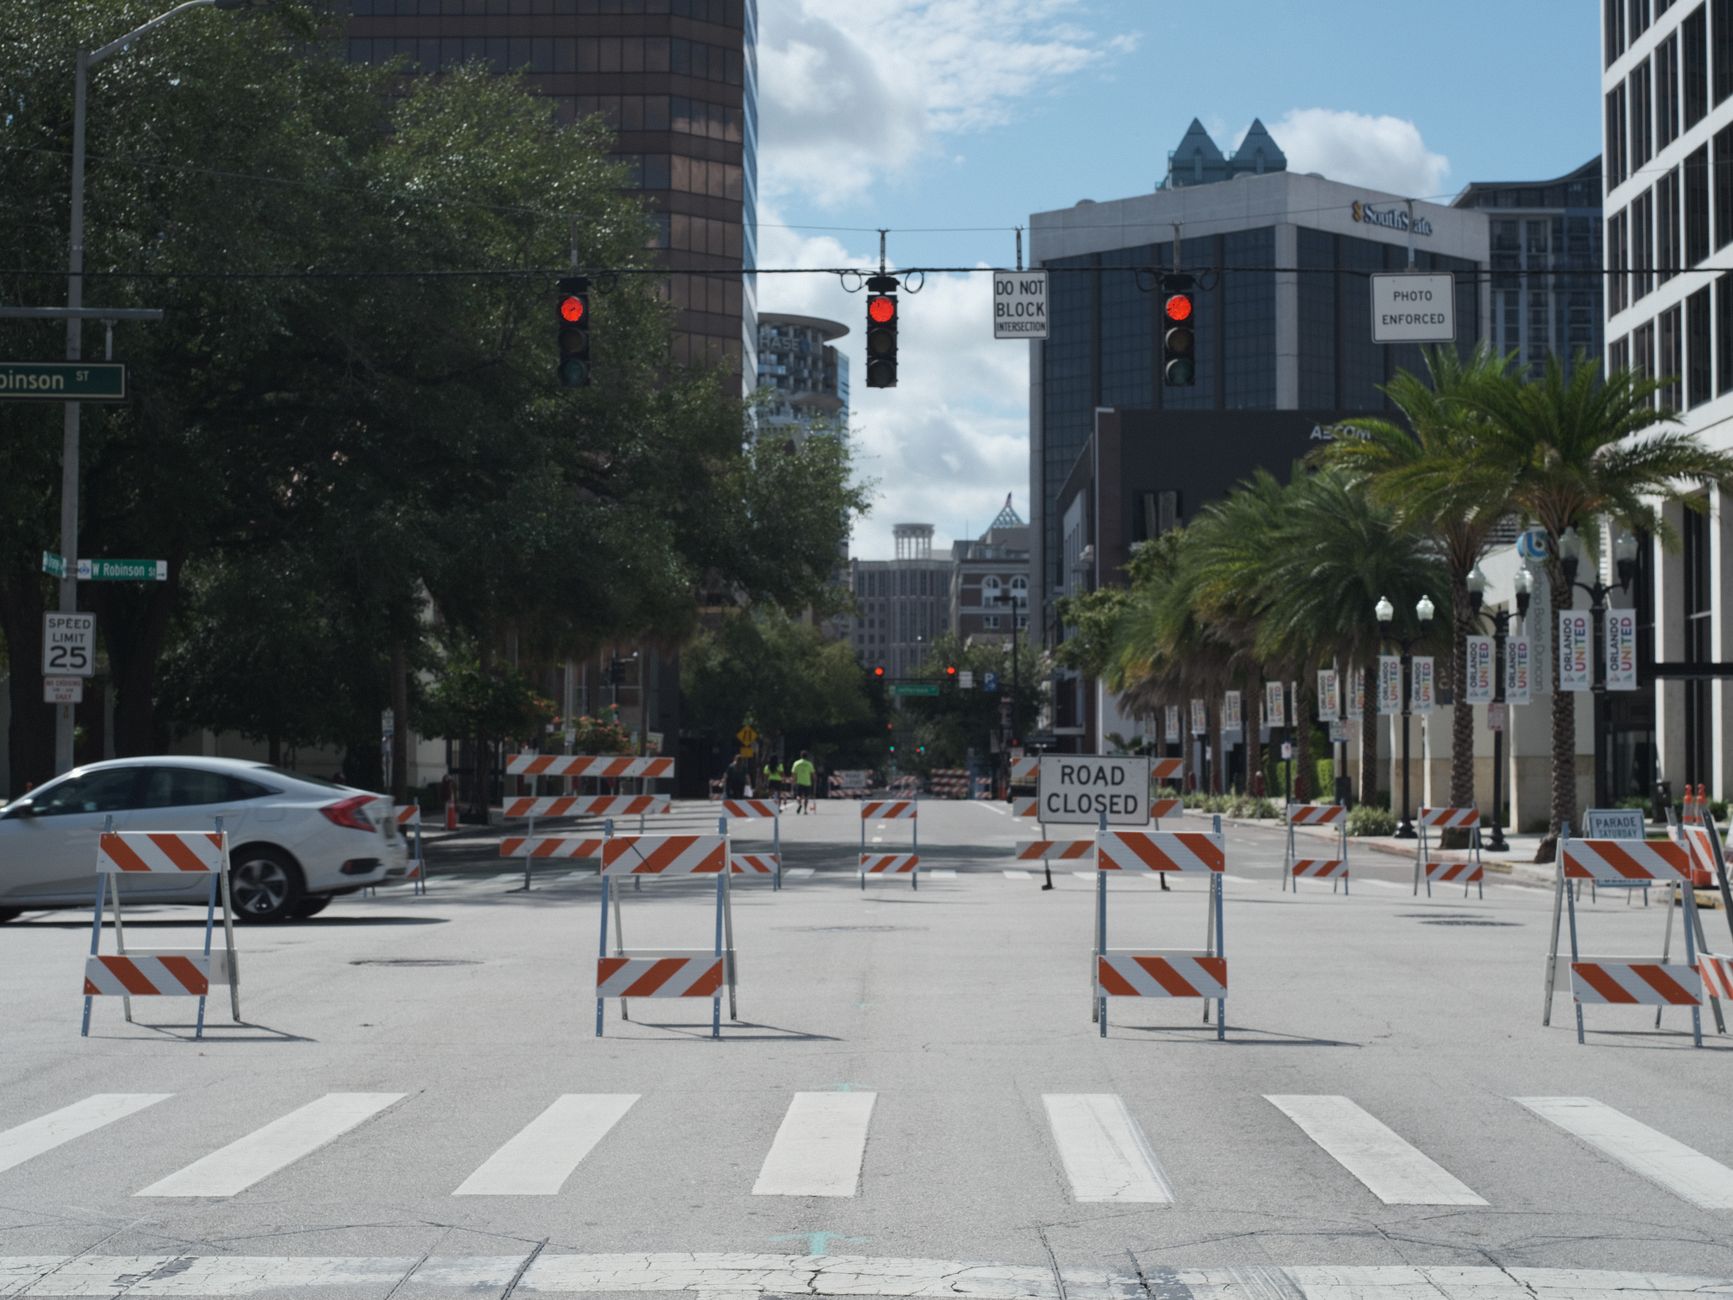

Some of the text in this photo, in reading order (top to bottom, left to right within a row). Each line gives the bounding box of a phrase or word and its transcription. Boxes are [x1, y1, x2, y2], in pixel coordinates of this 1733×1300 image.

[1363, 203, 1433, 236] SouthSate
[996, 280, 1044, 295] DO NOT
[1393, 290, 1433, 302] PHOTO
[996, 302, 1045, 317] BLOCK
[1382, 313, 1446, 325] ENFORCED
[996, 321, 1046, 332] INTERSECTION
[760, 335, 800, 350] HASE
[76, 370, 90, 381] ST
[92, 563, 100, 576] W
[103, 563, 145, 577] Robinson
[48, 618, 91, 629] SPEED
[52, 633, 85, 643] LIMIT
[1563, 618, 1572, 672] ORLANDO
[1575, 618, 1586, 672] UNITED
[1610, 617, 1619, 672] ORLANDO
[1621, 617, 1632, 672] UNITED
[49, 645, 87, 669] 25
[1470, 643, 1478, 688] ORLANDO
[1479, 643, 1489, 688] UNITED
[1518, 643, 1527, 688] UNITED
[1534, 645, 1545, 692] Duncan
[1061, 765, 1125, 786] ROAD
[1047, 793, 1138, 815] CLOSED
[1595, 816, 1637, 828] PARADE
